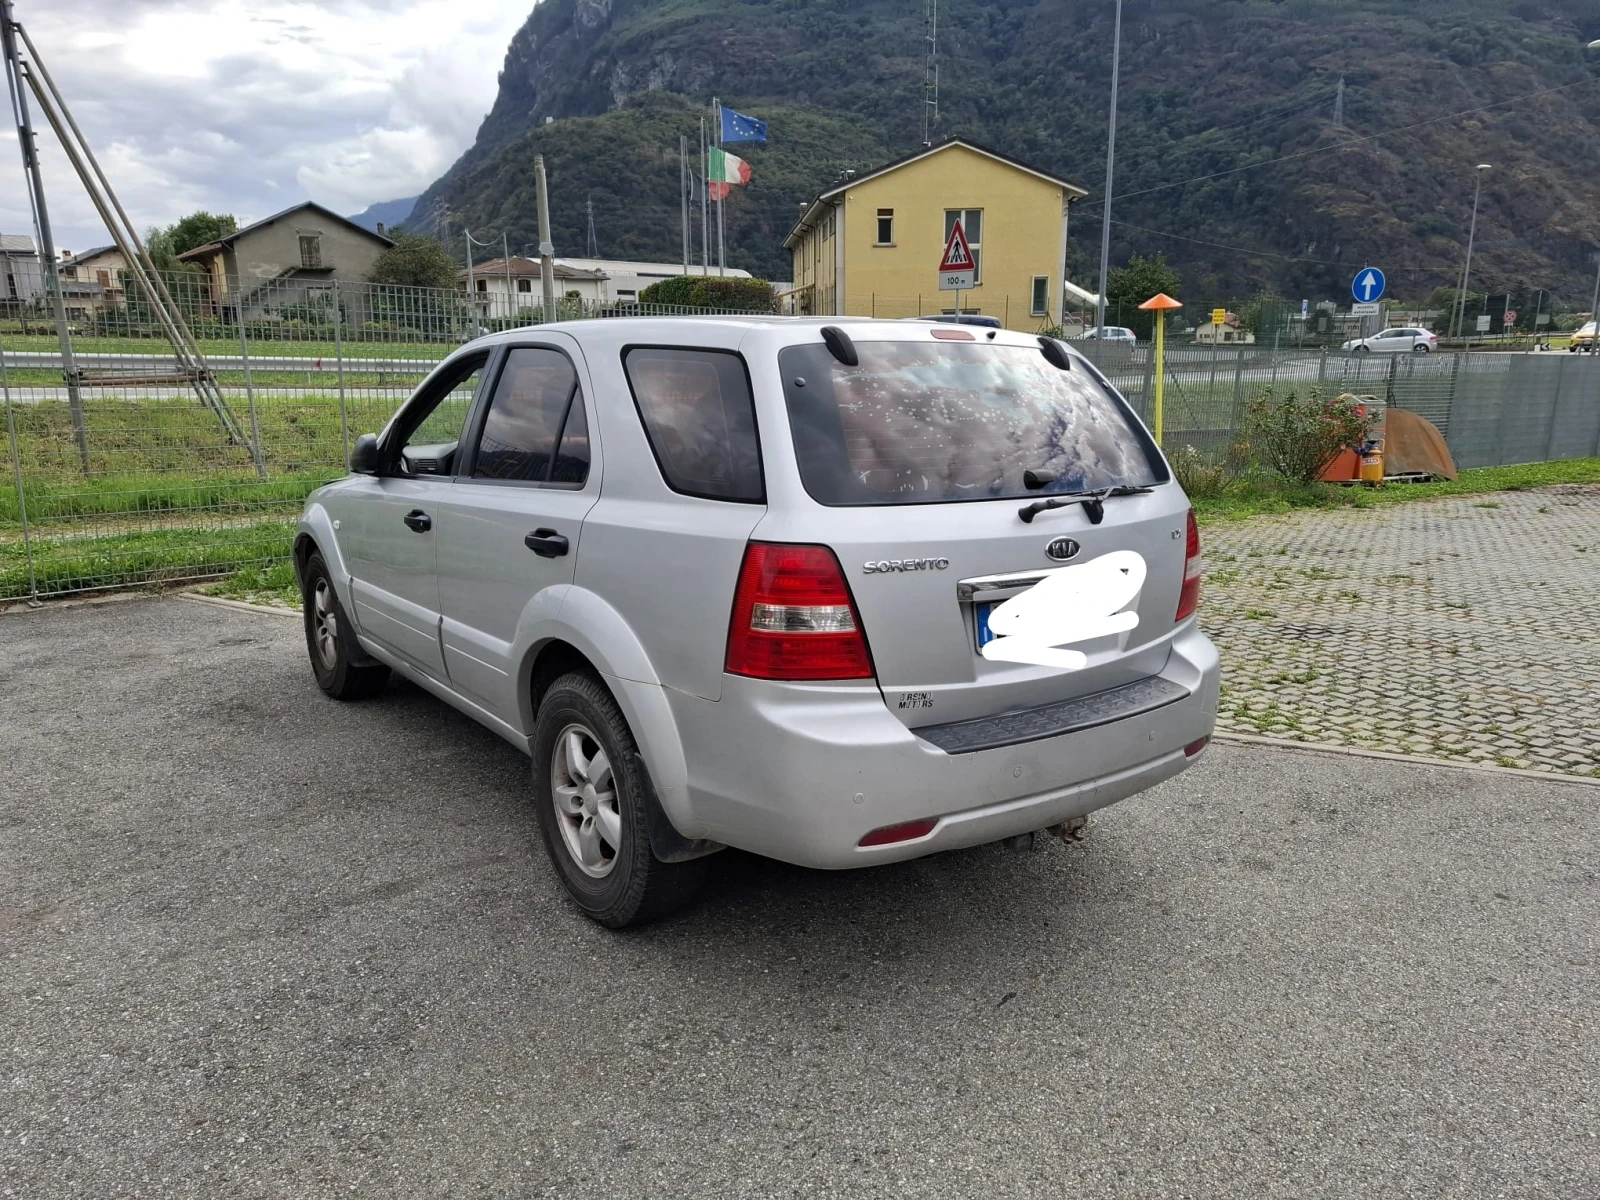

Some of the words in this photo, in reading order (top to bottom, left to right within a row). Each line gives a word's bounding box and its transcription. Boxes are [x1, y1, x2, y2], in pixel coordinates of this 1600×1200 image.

[947, 276, 959, 285] 100
[1051, 541, 1077, 557] KIA
[863, 557, 950, 574] SORENTO
